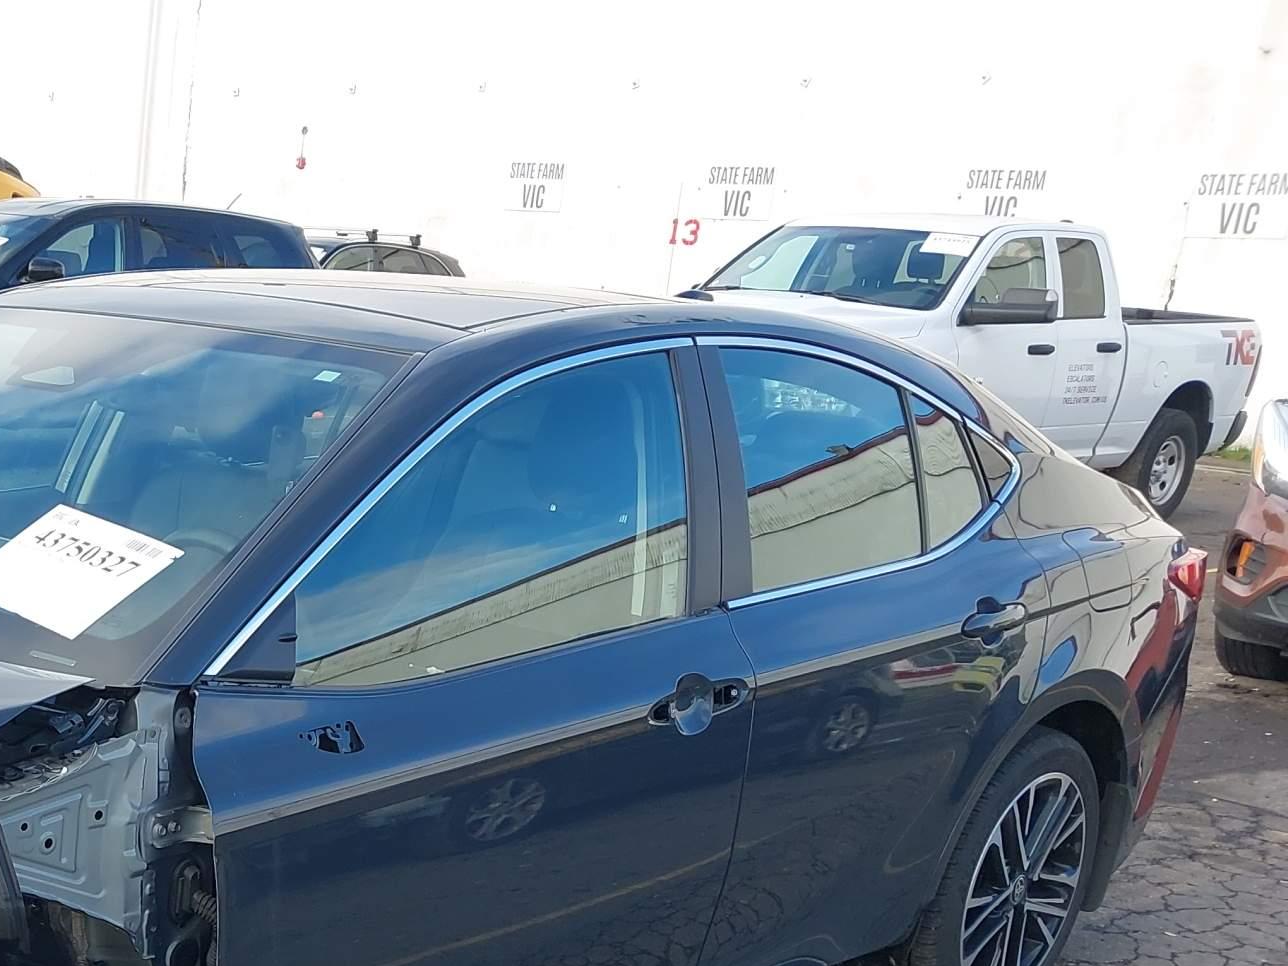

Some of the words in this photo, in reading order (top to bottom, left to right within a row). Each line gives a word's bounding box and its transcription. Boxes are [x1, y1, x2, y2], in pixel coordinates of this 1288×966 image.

[510, 162, 535, 179] STATE
[537, 163, 564, 180] FARM
[708, 166, 740, 185] STATE
[743, 167, 775, 185] FARM
[966, 169, 1004, 190] STATE
[1006, 170, 1047, 191] FARM
[522, 184, 546, 209] VIC
[1198, 173, 1244, 196] STATE
[723, 190, 751, 217] VIC
[985, 196, 1018, 217] VIC
[1219, 202, 1261, 235] VIC
[669, 218, 700, 245] 13
[34, 529, 142, 577] 43750327
